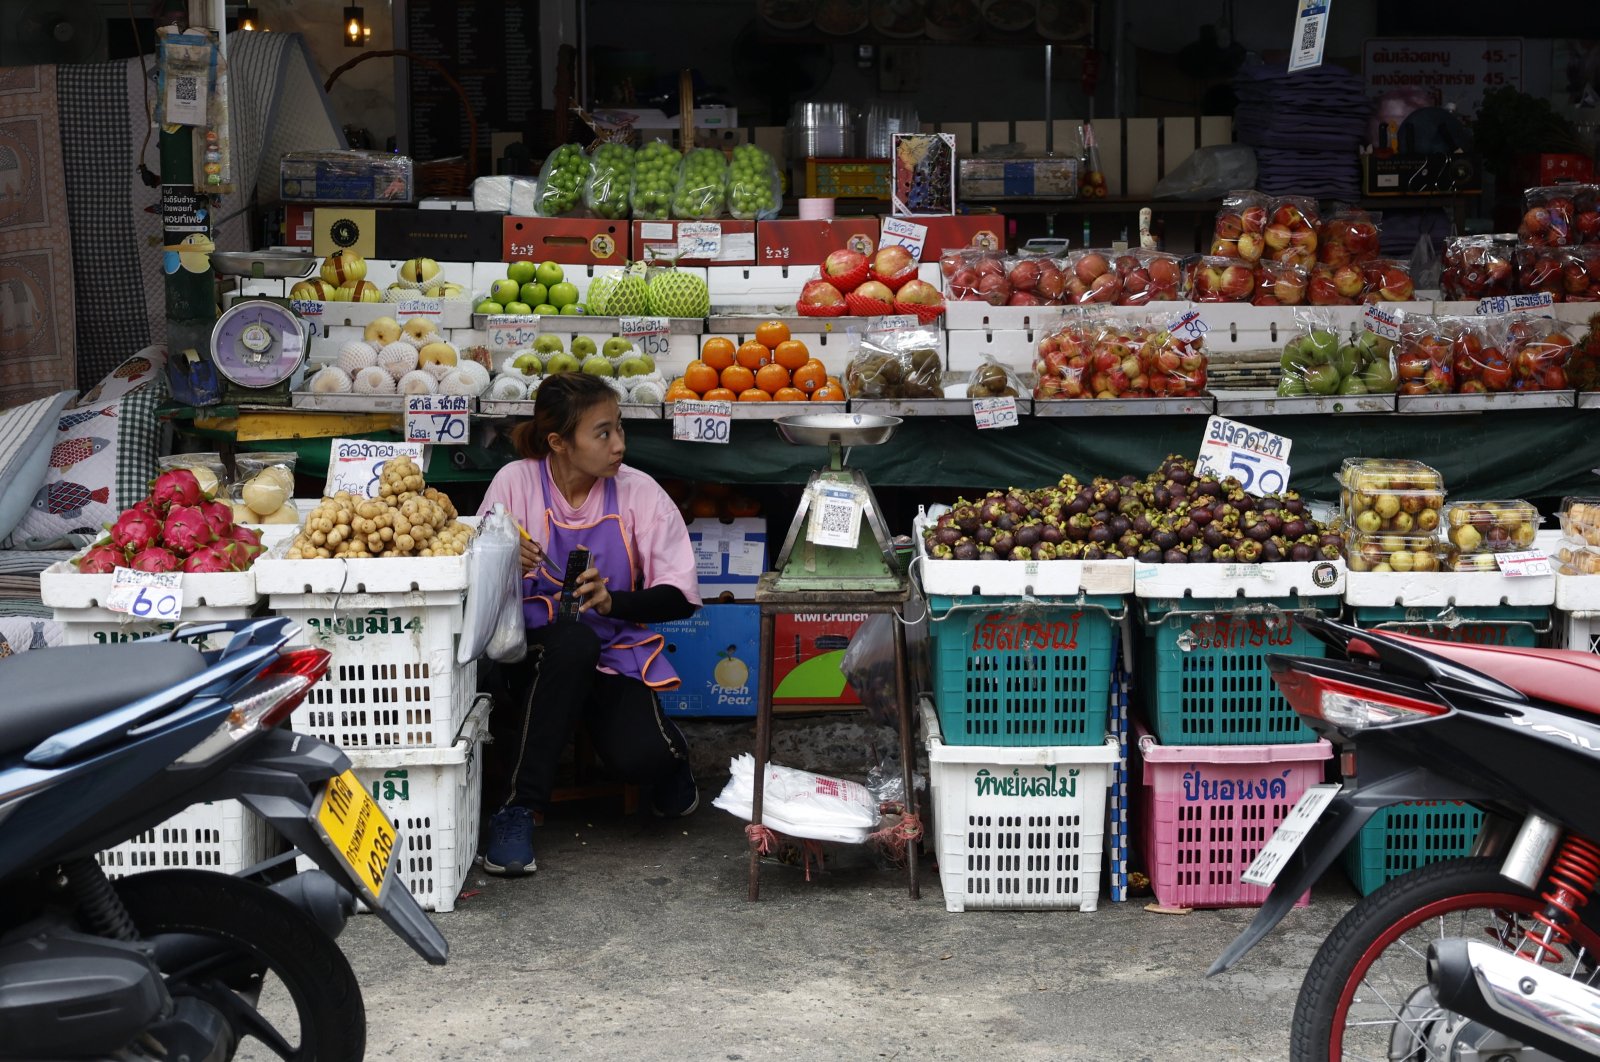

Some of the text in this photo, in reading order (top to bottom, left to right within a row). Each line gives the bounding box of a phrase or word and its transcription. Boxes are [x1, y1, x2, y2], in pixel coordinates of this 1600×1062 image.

[1185, 319, 1209, 339] 80
[431, 413, 465, 442] 70
[1229, 451, 1284, 495] 50
[710, 683, 750, 696] Fresh
[717, 695, 757, 706] Pear
[974, 764, 1081, 798] ทิพย์ผลไม้
[1182, 763, 1292, 801] ปิ่นอนงค์
[367, 826, 393, 887] 4236
